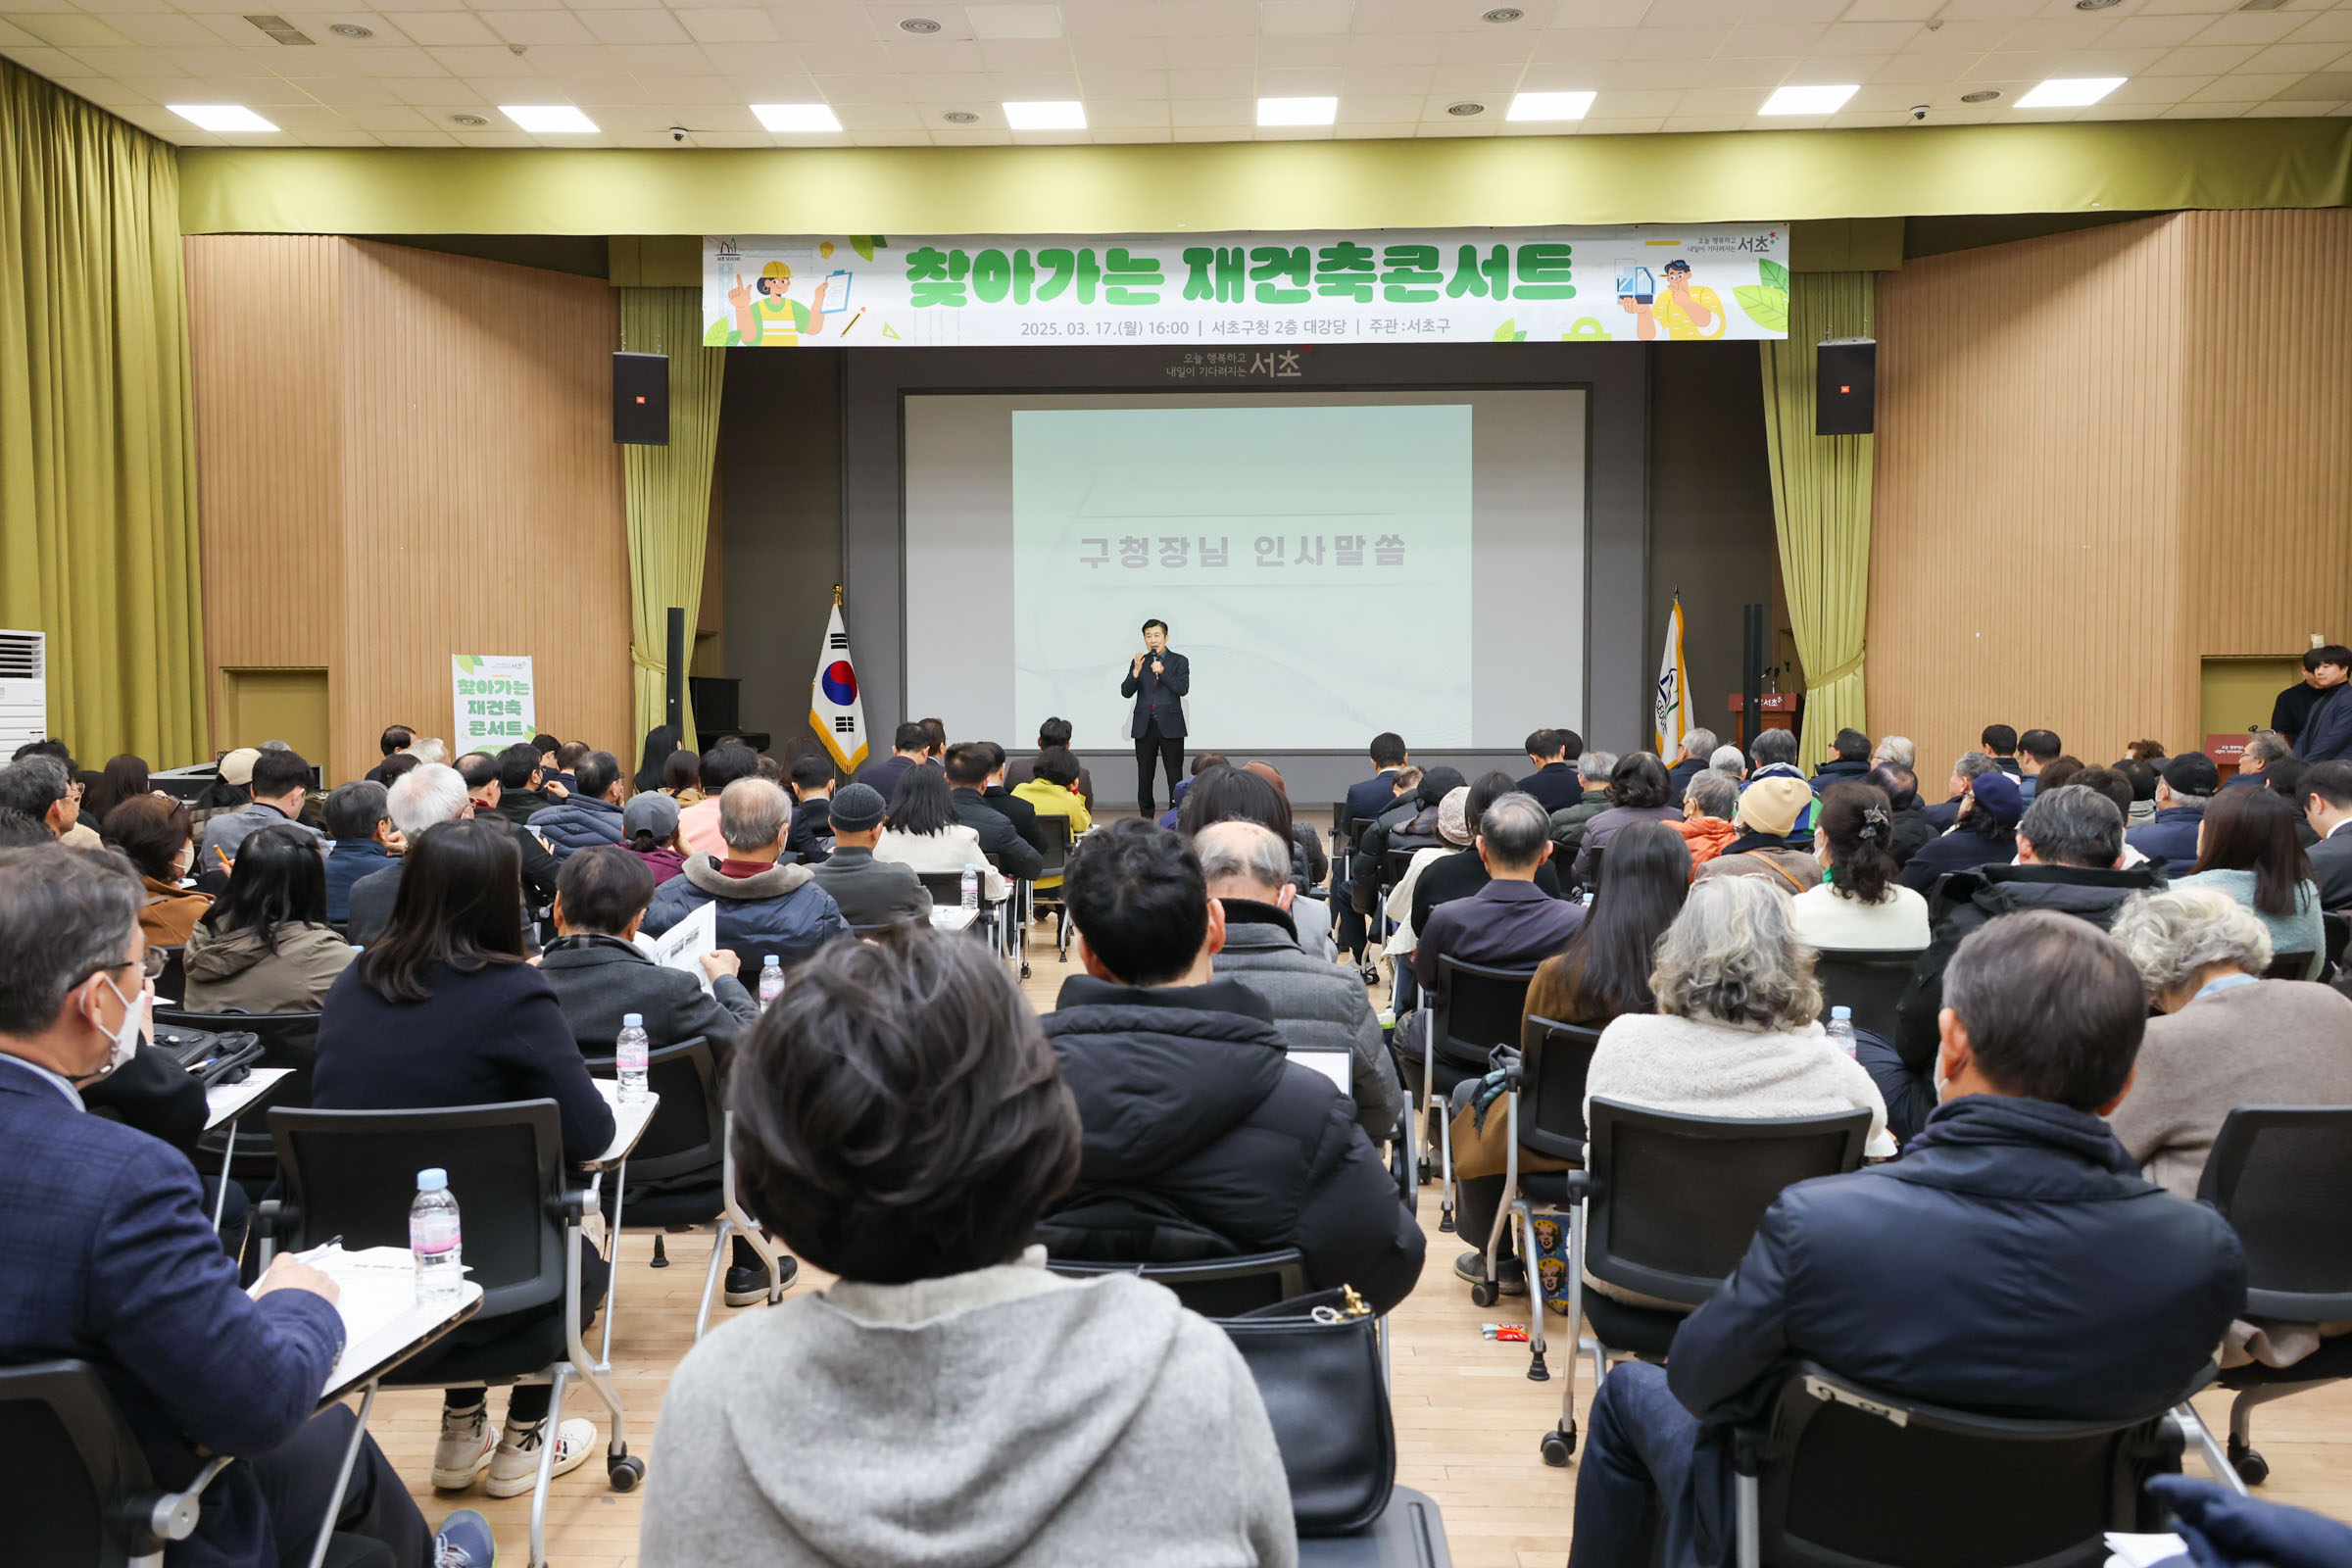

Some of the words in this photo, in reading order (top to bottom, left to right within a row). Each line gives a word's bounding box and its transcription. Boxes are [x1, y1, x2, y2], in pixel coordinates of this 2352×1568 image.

[1738, 235, 1769, 253] 서초
[906, 247, 1165, 307] 찾아가는
[1183, 241, 1577, 304] 재건축콘서트
[1021, 322, 1062, 336] 2025.
[1067, 321, 1090, 335] 03.
[1150, 321, 1189, 335] 16:00
[1211, 319, 1269, 336] 서초구청
[1274, 319, 1298, 335] 2층
[1303, 319, 1347, 335] 대강당
[1183, 353, 1203, 364] 오늘
[1207, 353, 1247, 364] 행복하고
[1250, 350, 1301, 378] 서초
[1166, 367, 1196, 378] 내일이
[1200, 367, 1247, 377] 기다려지는
[1079, 535, 1230, 568] 구청장님
[1253, 533, 1406, 568] 인사말씀
[457, 678, 530, 696] 찾아가는
[467, 699, 522, 715] 재건축
[468, 720, 523, 736] 콘서트
